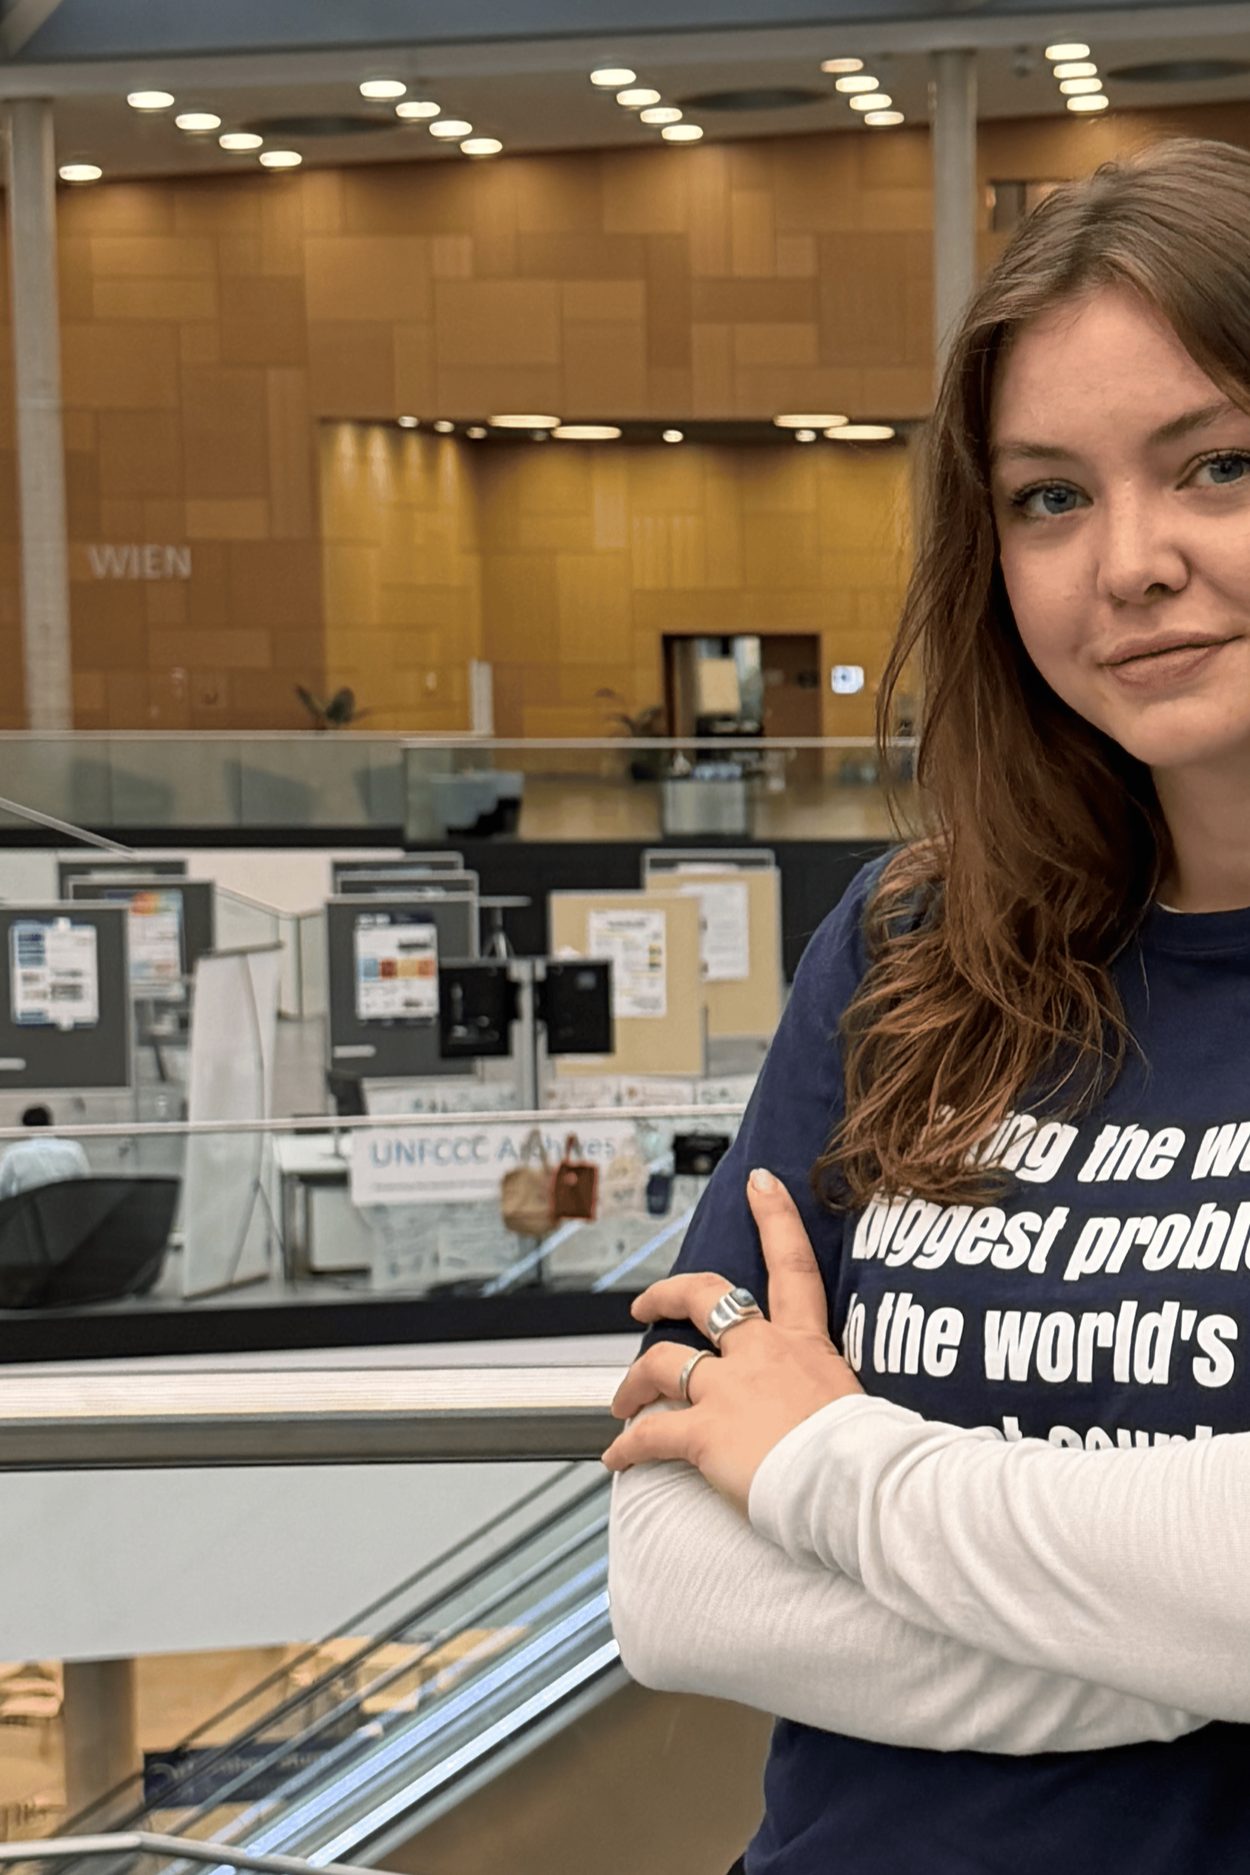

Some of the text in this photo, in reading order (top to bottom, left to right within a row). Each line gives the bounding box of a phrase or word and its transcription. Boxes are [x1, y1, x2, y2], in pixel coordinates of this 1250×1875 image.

[88, 542, 191, 579] WIEN
[371, 1135, 488, 1169] UNFCCC
[1077, 1114, 1186, 1182] the
[852, 1187, 1070, 1274] biggest
[873, 1292, 965, 1377] the
[984, 1300, 1238, 1388] world's
